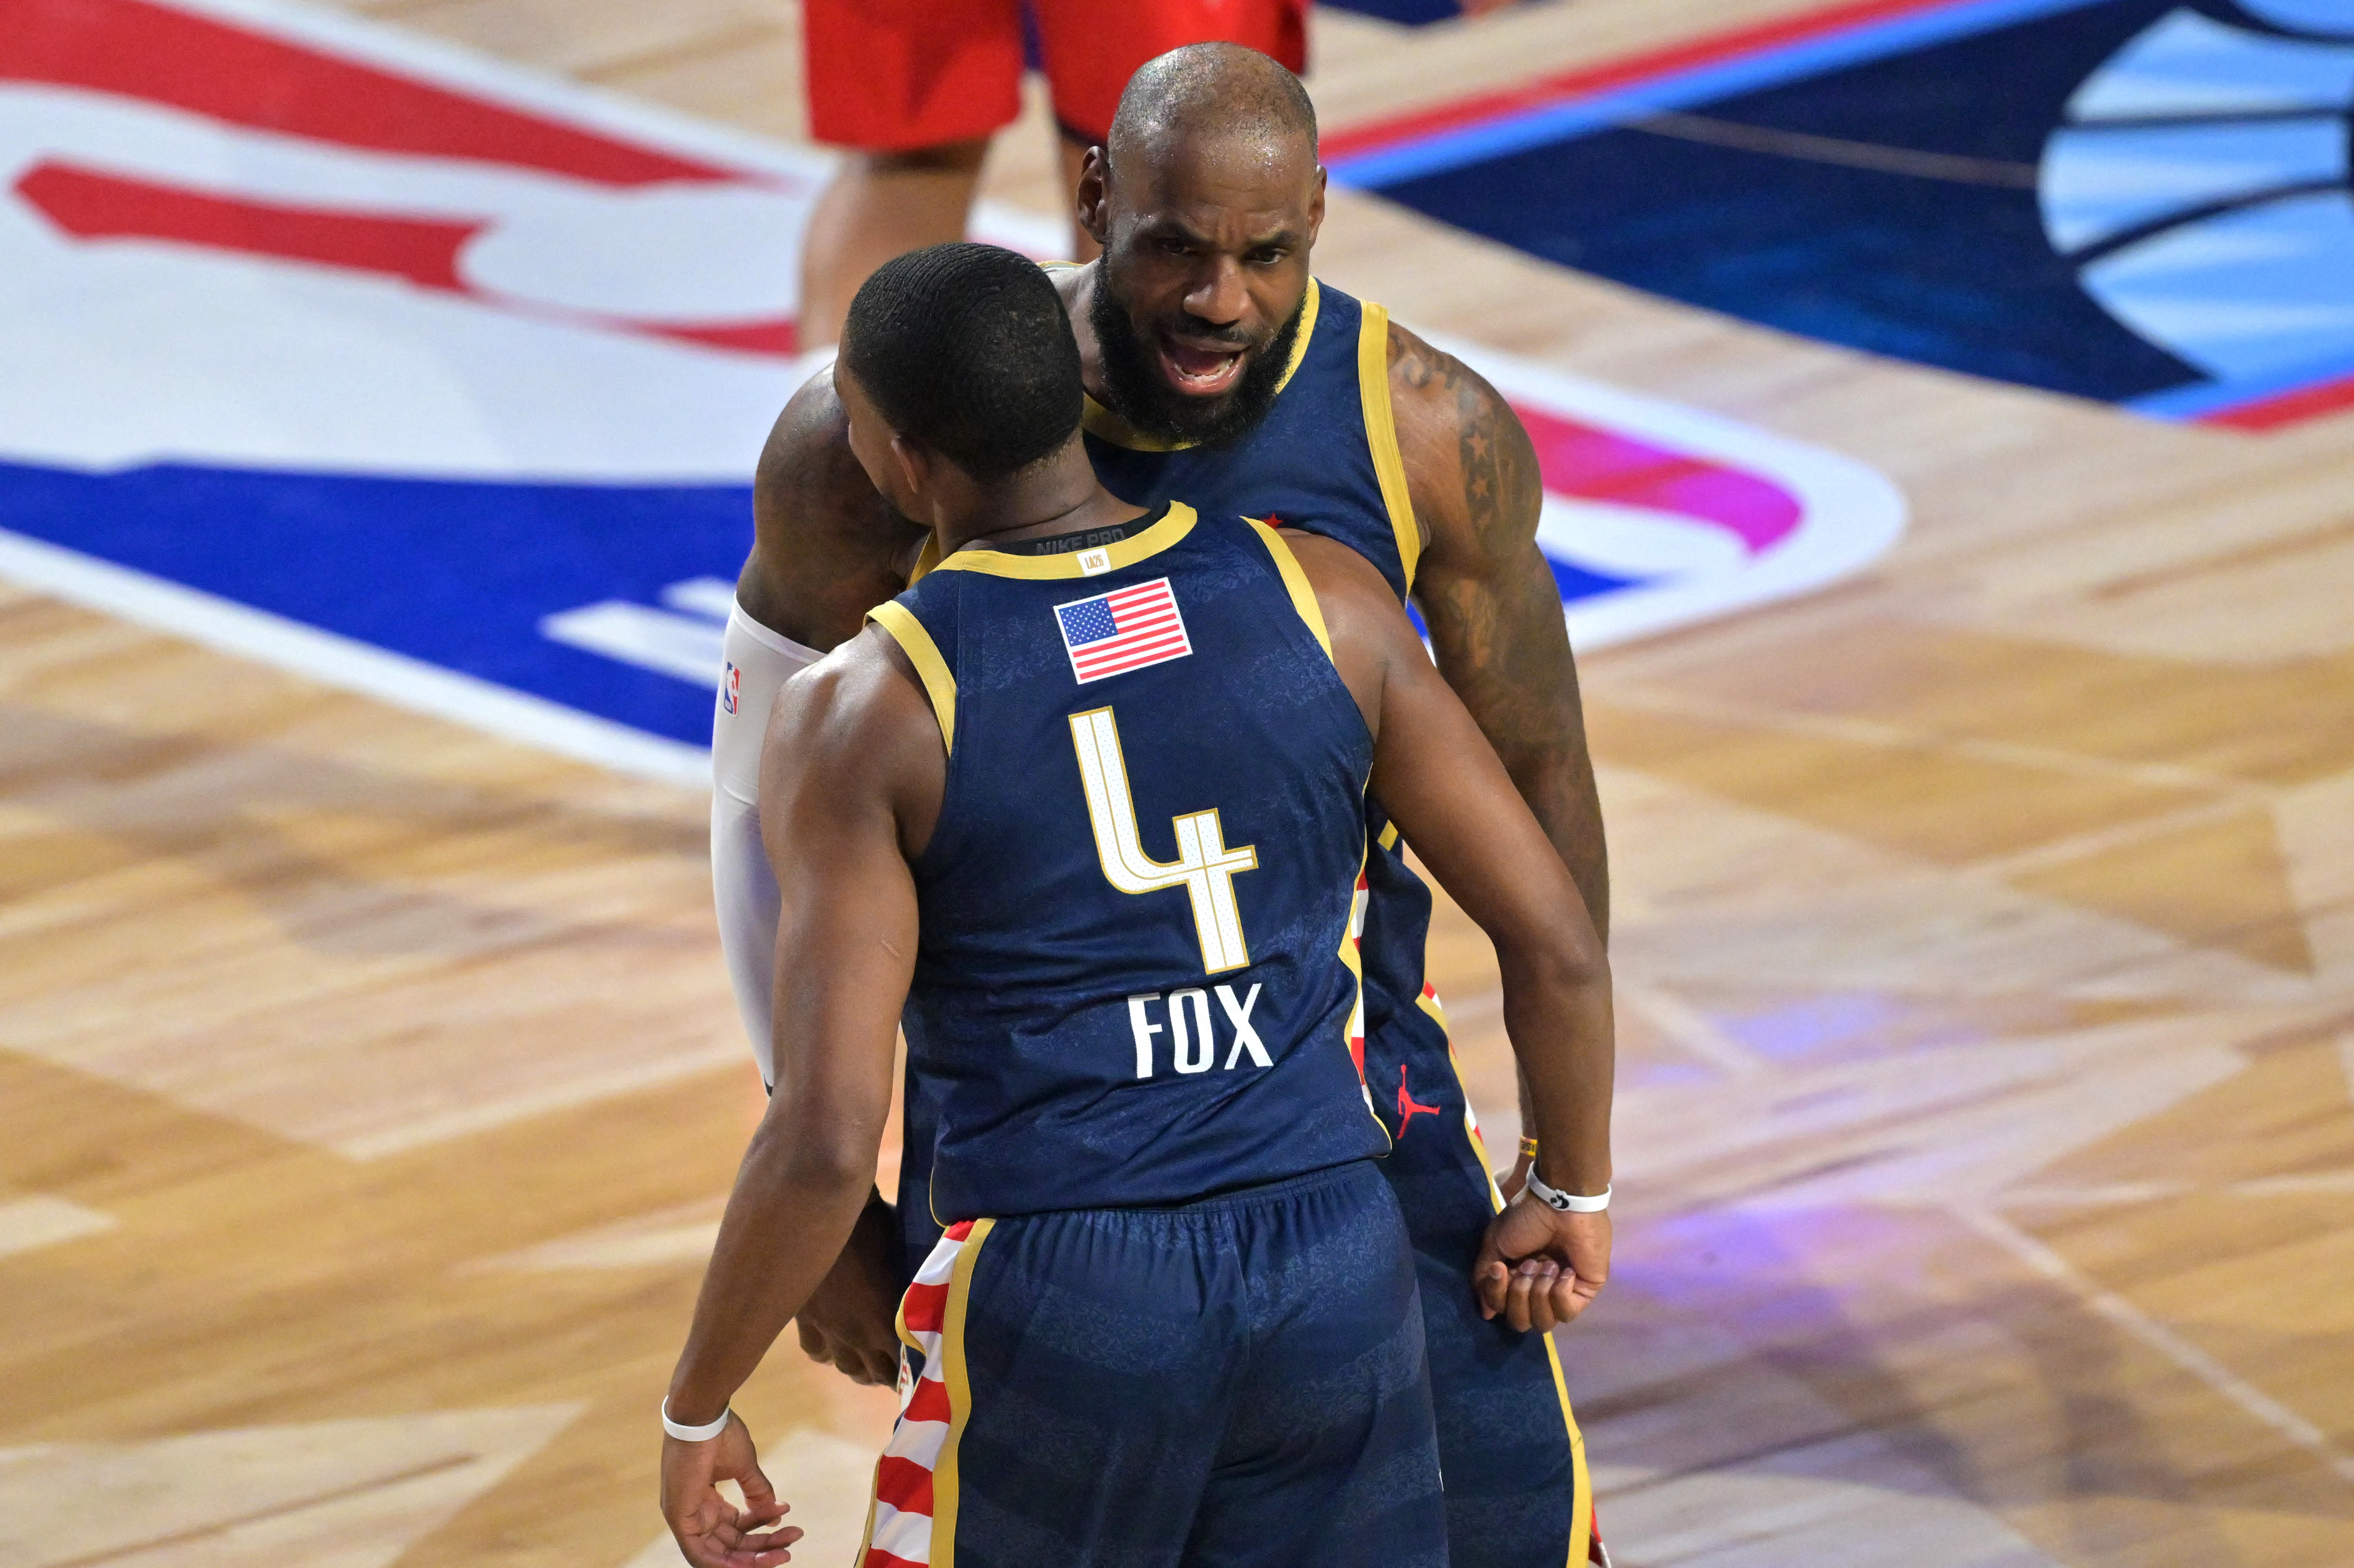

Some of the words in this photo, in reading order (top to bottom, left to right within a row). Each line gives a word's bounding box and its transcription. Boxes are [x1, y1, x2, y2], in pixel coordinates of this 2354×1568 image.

[1036, 535, 1082, 555] NIKE
[1086, 527, 1126, 548] PRO
[1068, 705, 1259, 976] 4
[1127, 983, 1274, 1079] FOX
